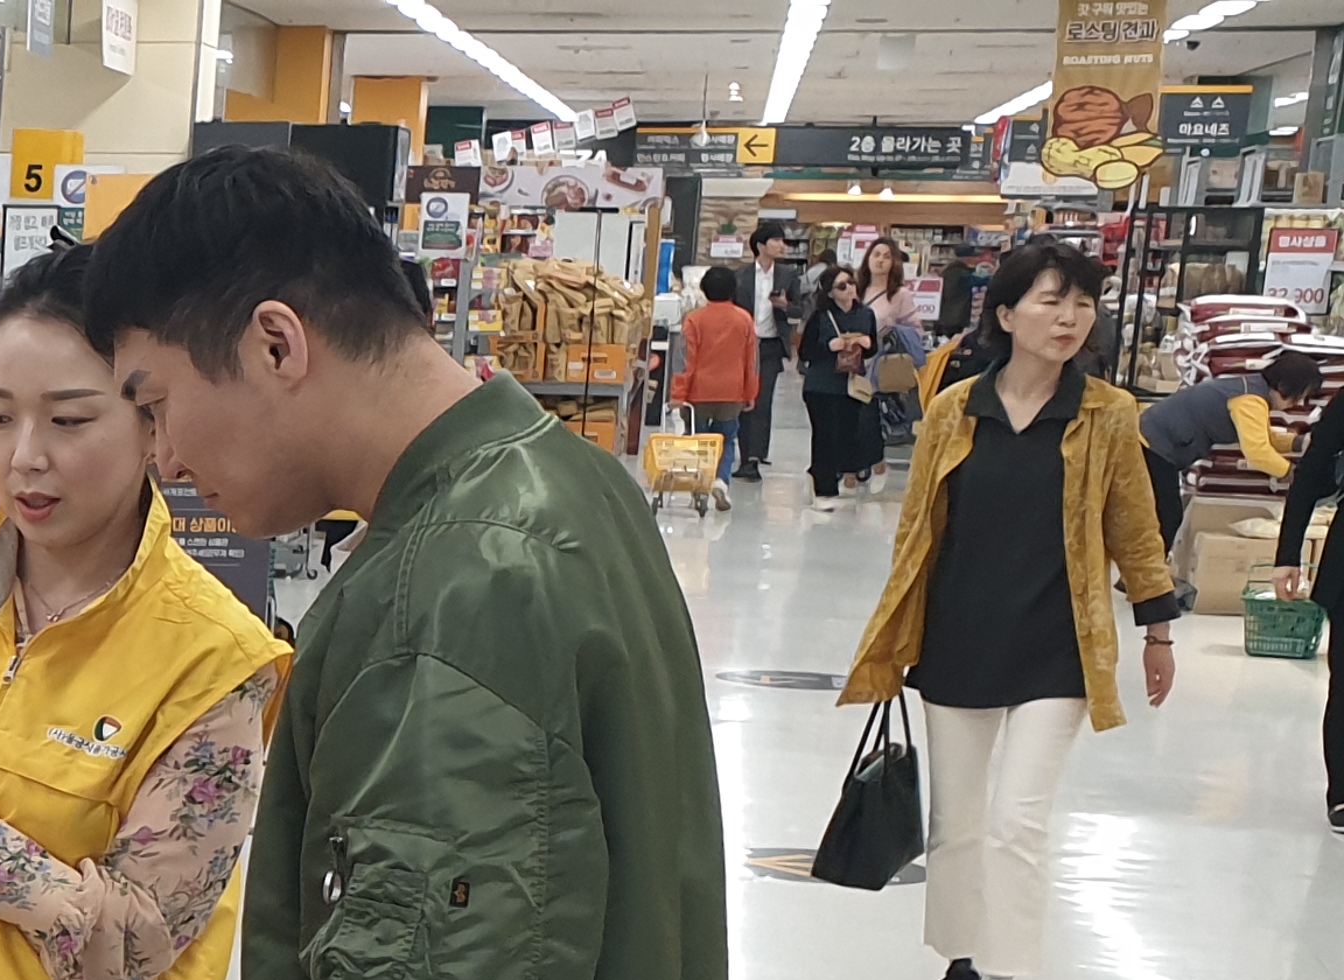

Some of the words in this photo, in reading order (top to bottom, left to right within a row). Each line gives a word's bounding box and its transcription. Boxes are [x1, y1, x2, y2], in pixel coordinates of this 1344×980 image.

[1065, 20, 1120, 42] 로스팅
[1123, 19, 1158, 41] 견과
[1179, 123, 1230, 136] 마요네즈
[881, 136, 942, 153] 올라가는
[946, 136, 961, 153] 곳
[24, 163, 43, 193] 5
